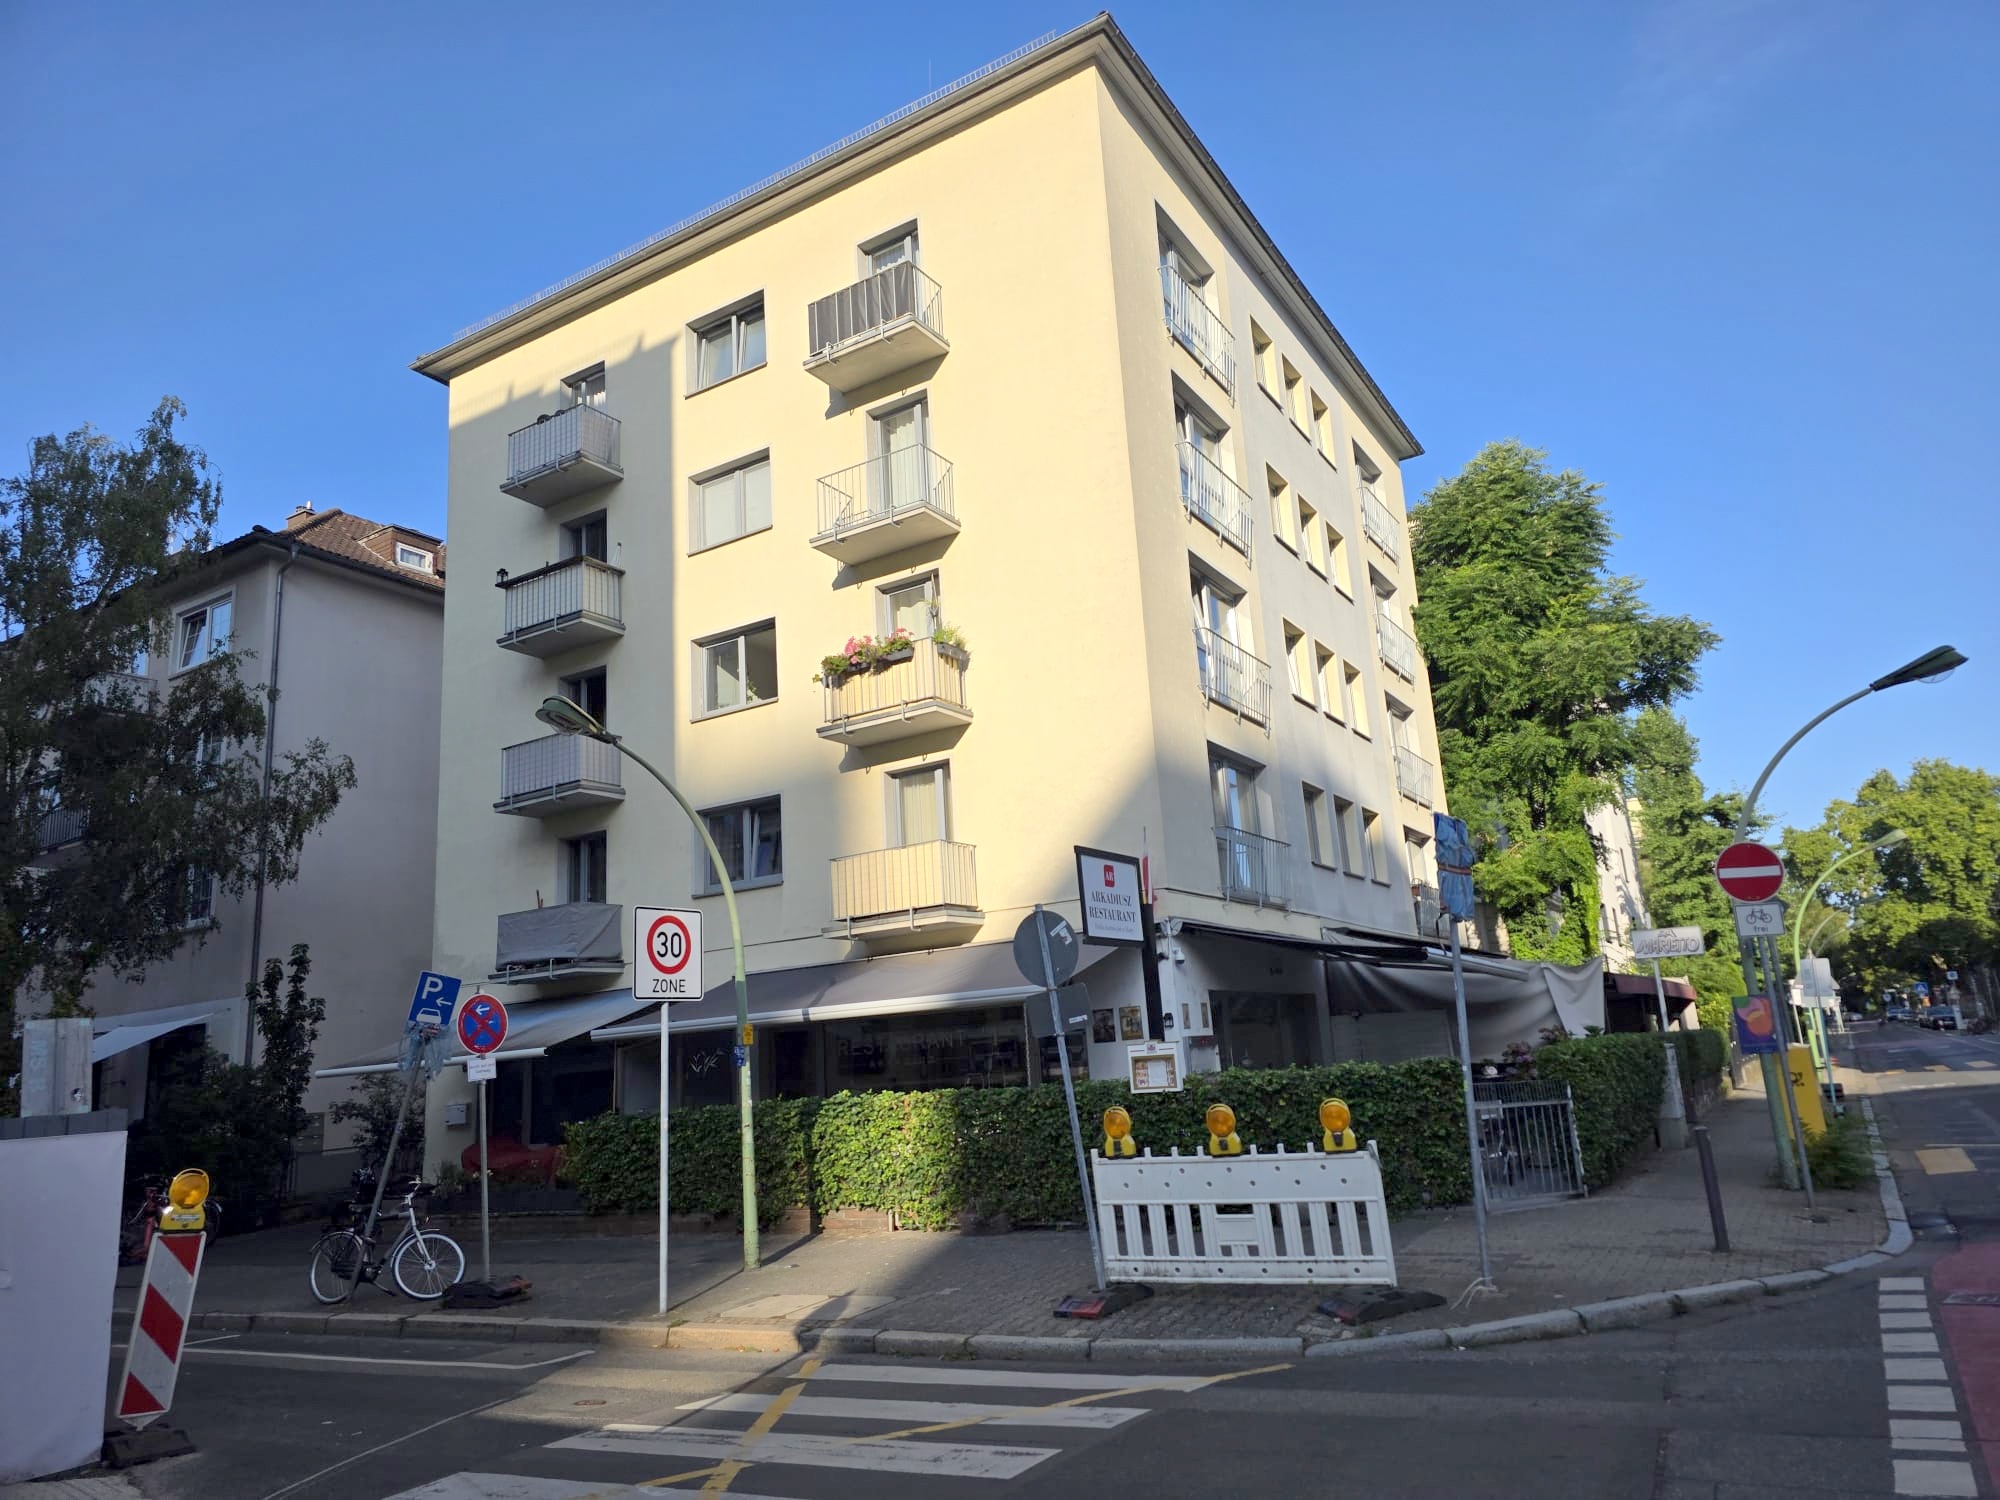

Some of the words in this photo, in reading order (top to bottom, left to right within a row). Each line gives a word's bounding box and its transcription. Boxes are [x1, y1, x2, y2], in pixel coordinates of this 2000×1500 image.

[1091, 890, 1132, 907] ARKADIUSZ
[1088, 906, 1136, 923] RESTAURANT
[1753, 924, 1769, 933] frei
[656, 931, 682, 958] 30
[421, 976, 444, 1000] P
[652, 978, 686, 993] ZONE
